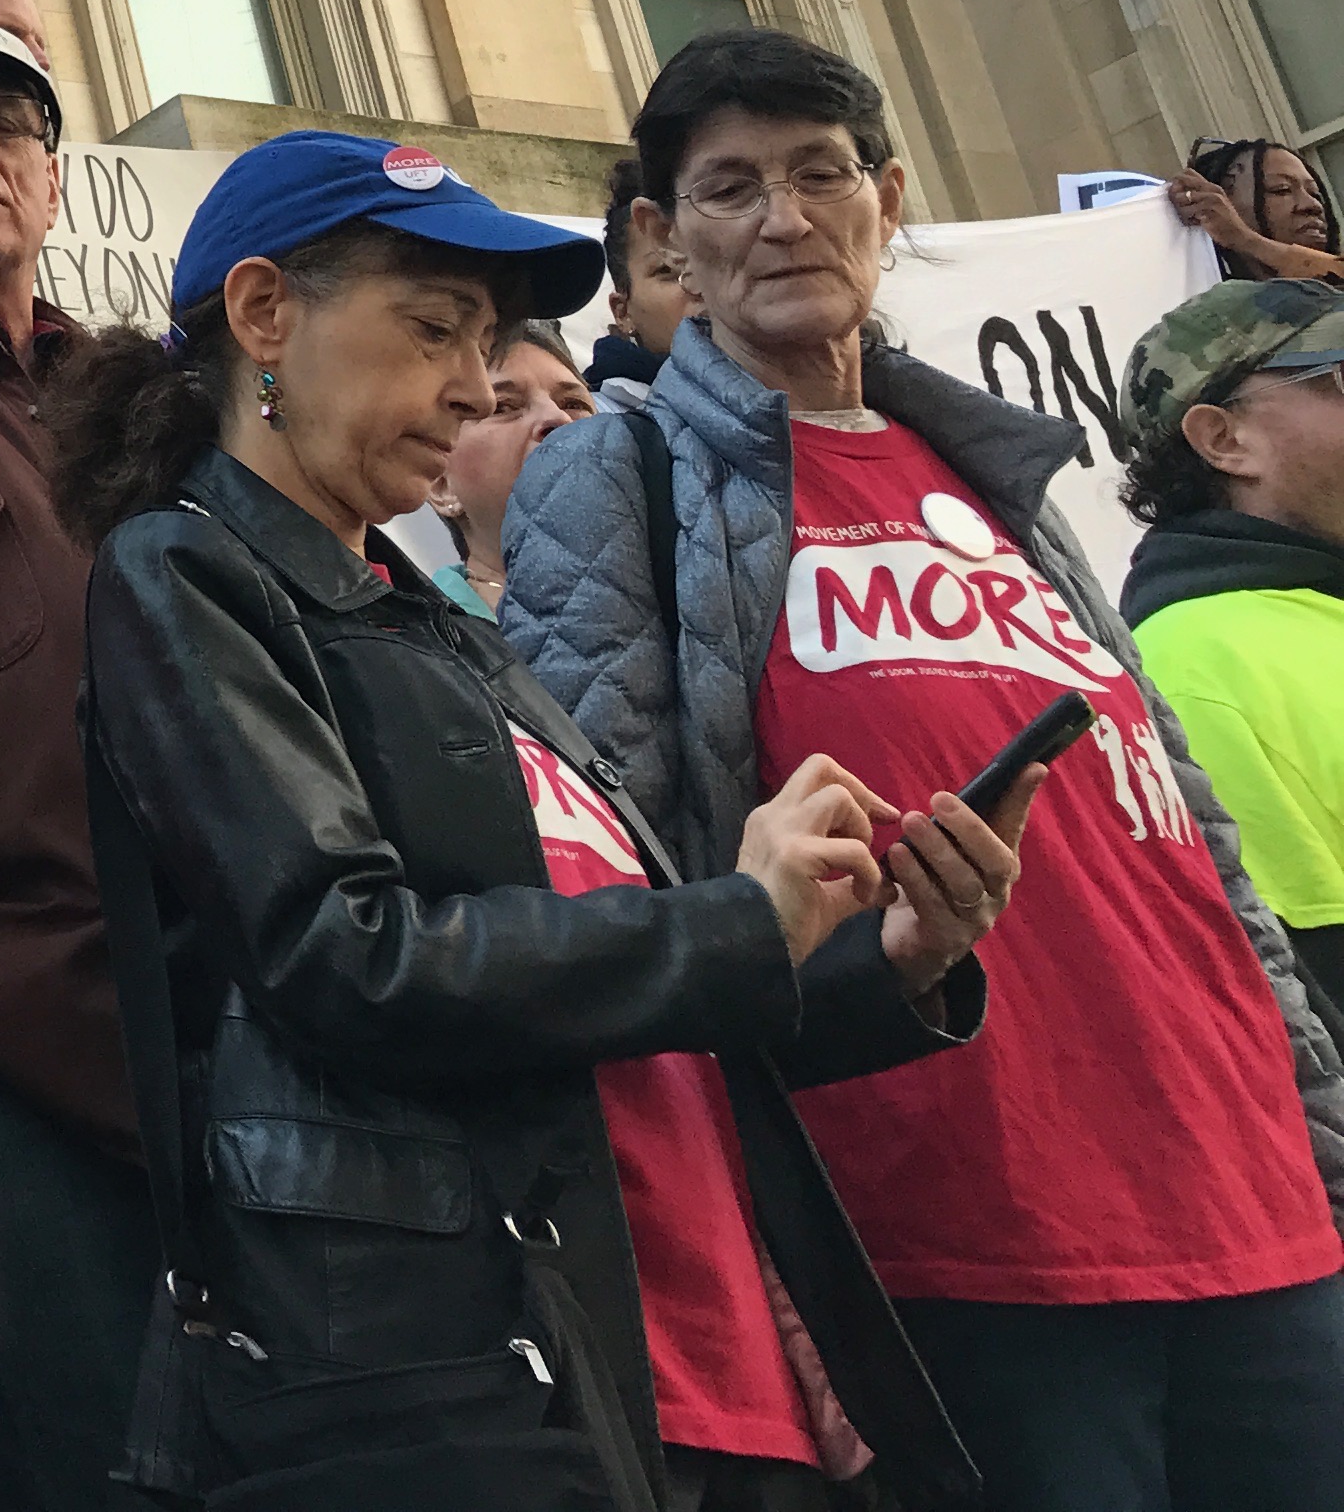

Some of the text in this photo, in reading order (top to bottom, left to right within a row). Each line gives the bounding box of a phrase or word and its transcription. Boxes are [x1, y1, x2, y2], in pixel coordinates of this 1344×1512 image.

[387, 157, 437, 169] MORE
[84, 154, 154, 242] DO
[795, 521, 883, 542] MOVEMENT
[884, 520, 906, 536] OF
[814, 561, 1097, 662] MORE
